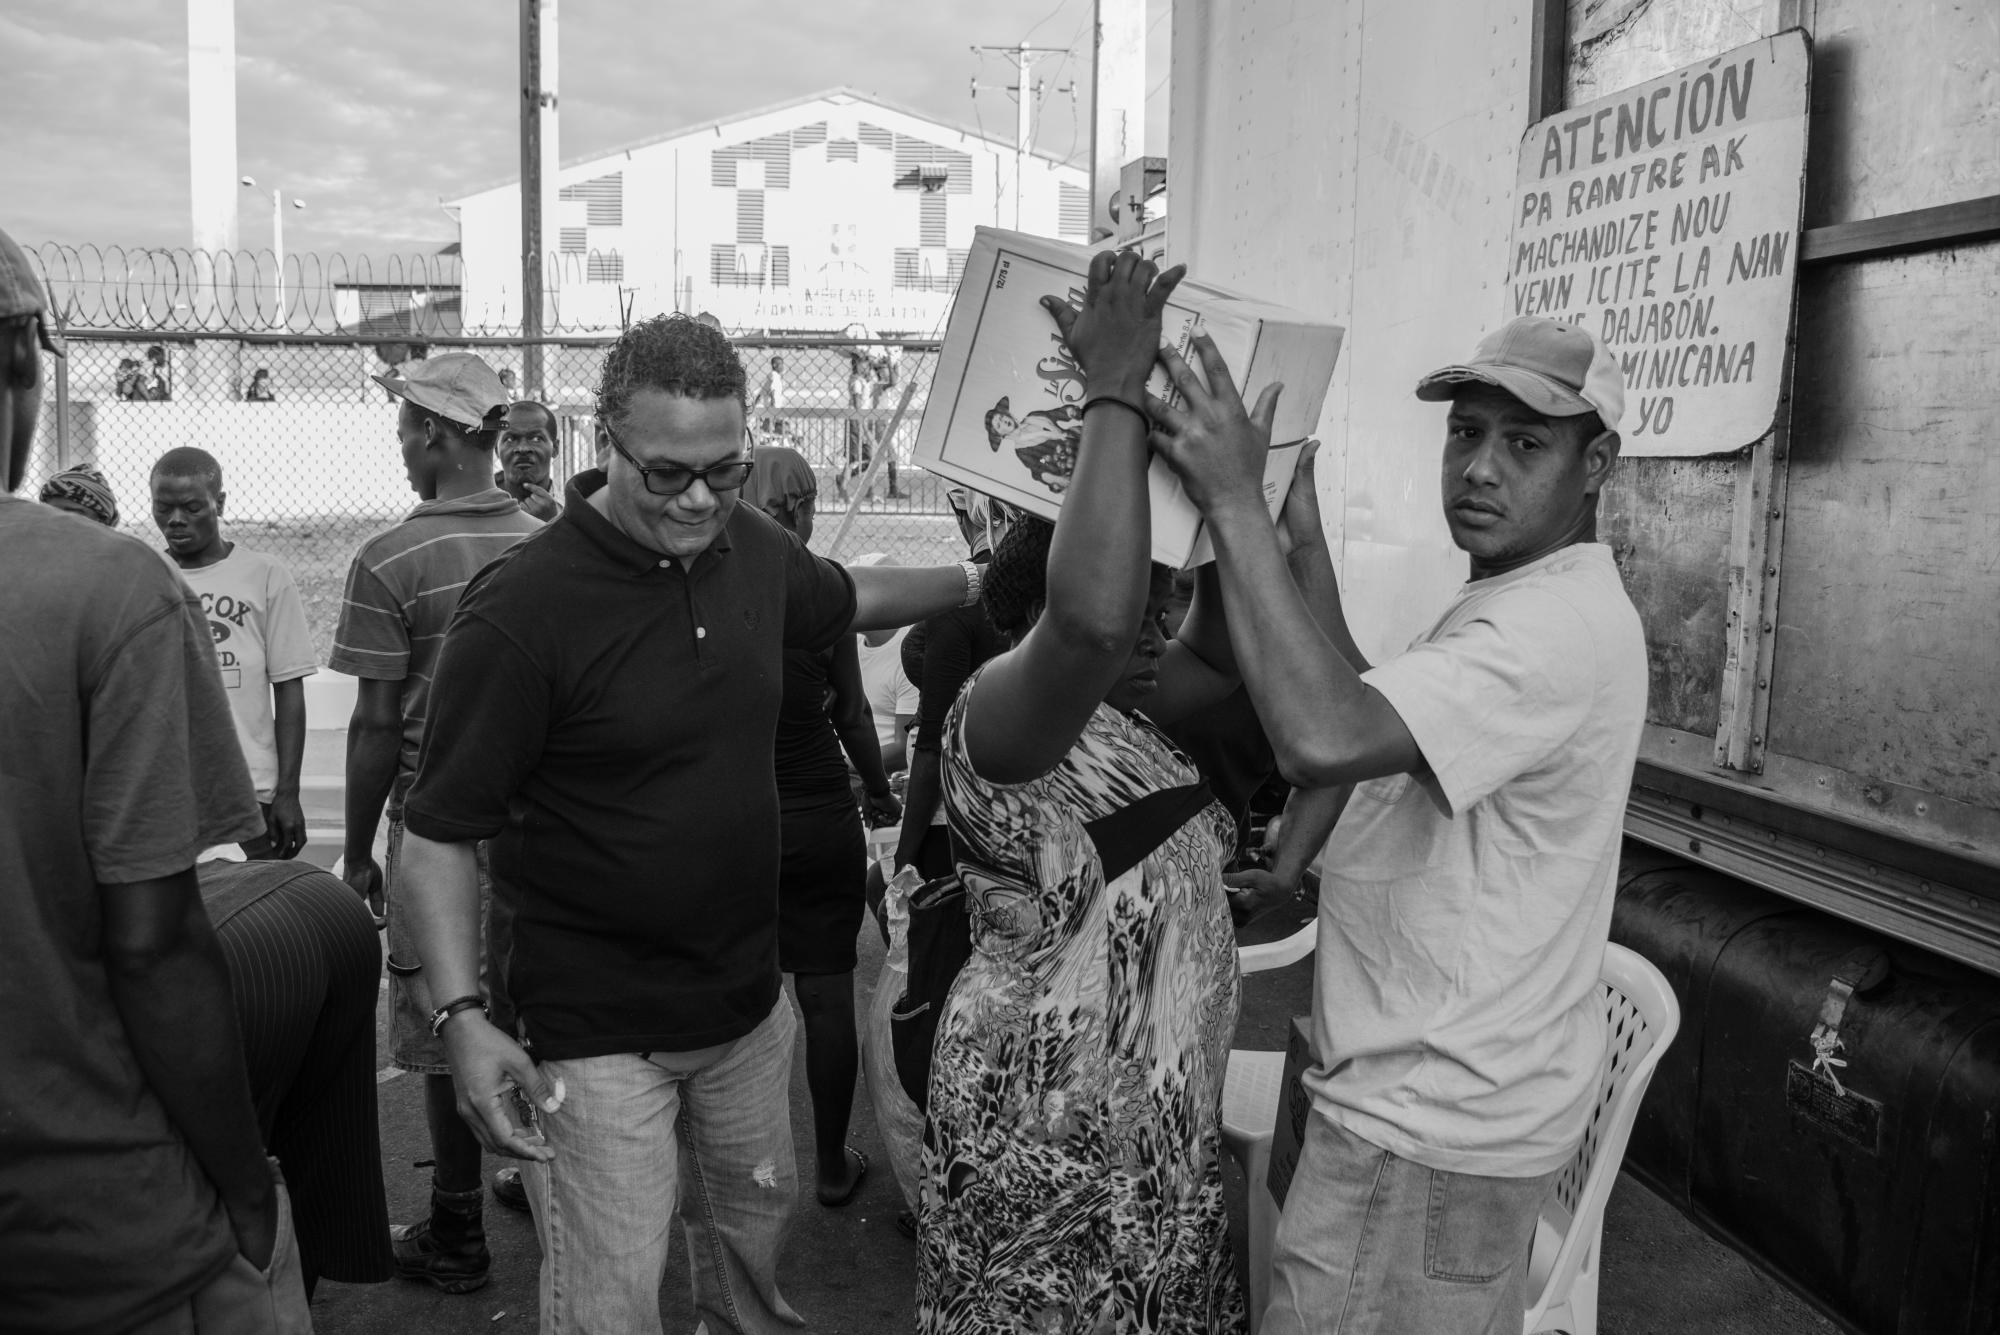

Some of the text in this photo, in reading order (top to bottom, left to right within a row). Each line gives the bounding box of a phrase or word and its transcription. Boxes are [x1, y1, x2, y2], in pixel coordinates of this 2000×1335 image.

[1539, 57, 1755, 179] ATENCIÓN
[1519, 133, 1748, 229] PA RANTRE AK
[1514, 191, 1731, 276] MACHANDIZE NOU
[1514, 230, 1790, 317] VENN ICITE LA NAN
[1601, 287, 1719, 345] DAJABÓN.
[1621, 341, 1755, 390] MINICANA
[200, 592, 251, 627] COX
[217, 651, 240, 667] D.
